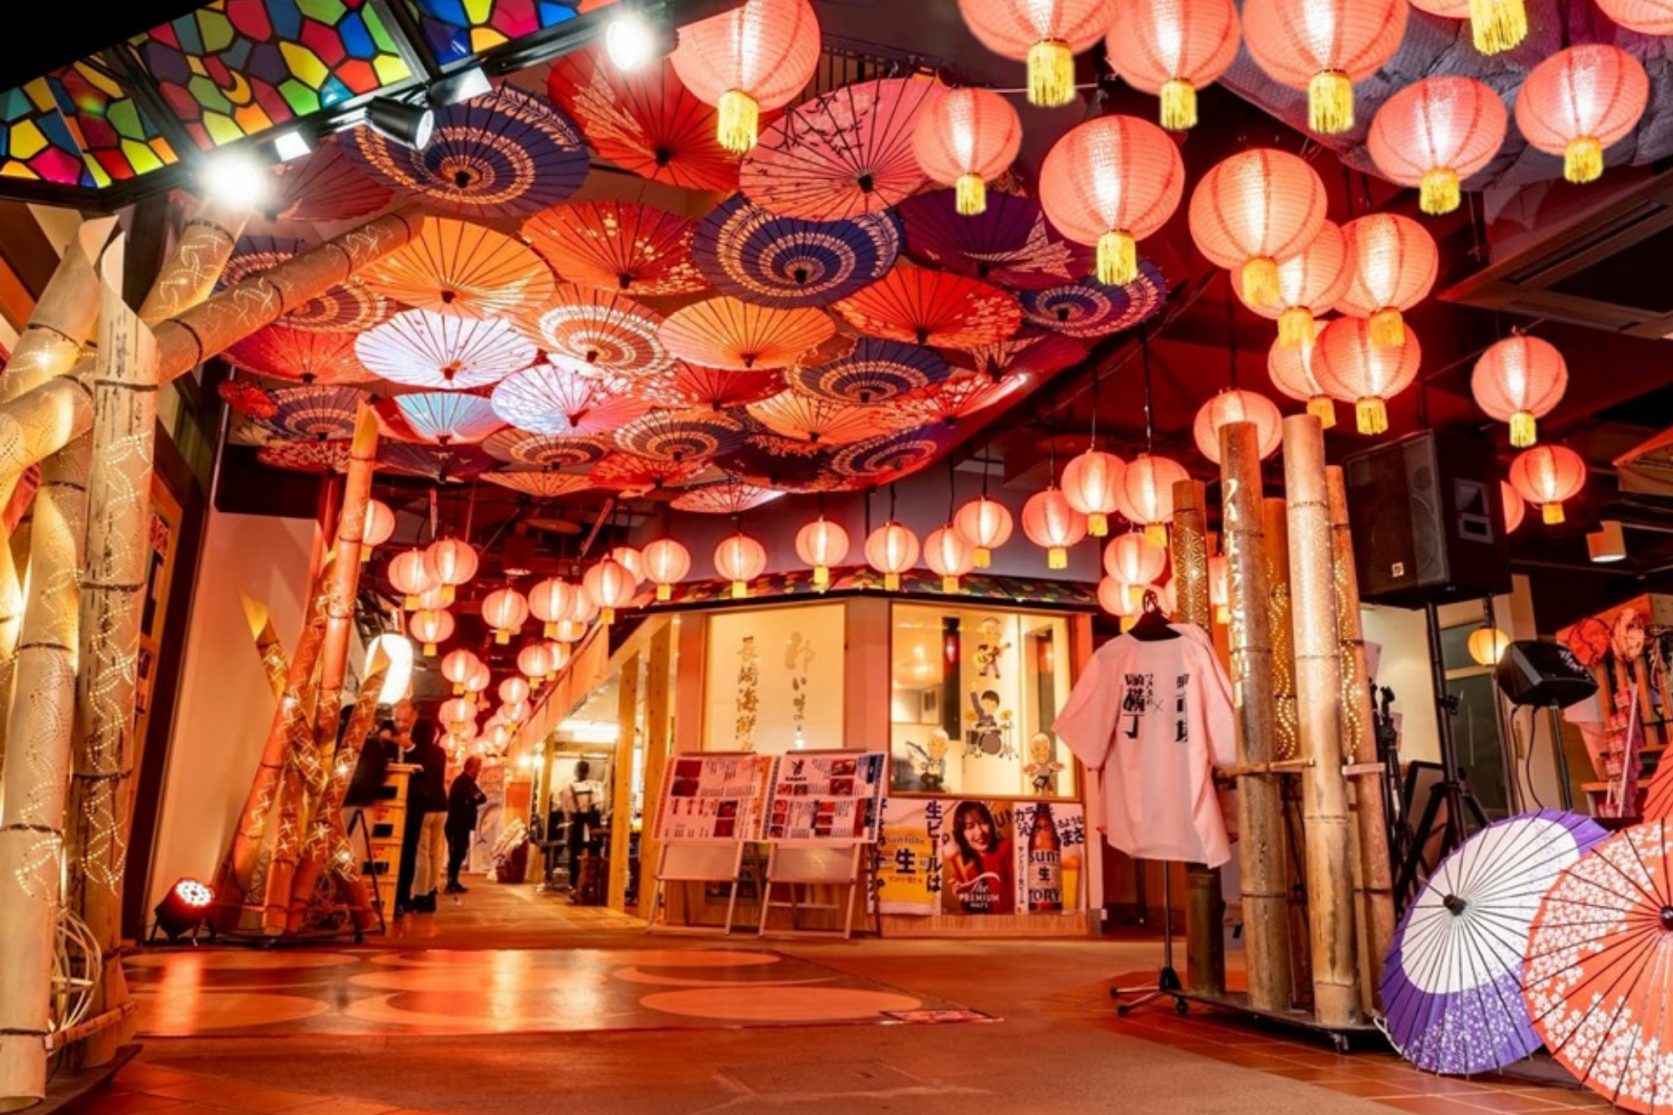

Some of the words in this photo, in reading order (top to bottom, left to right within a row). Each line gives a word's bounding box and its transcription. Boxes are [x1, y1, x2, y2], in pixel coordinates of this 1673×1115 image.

[925, 799, 942, 893] 生ビールは
[895, 848, 916, 874] 生
[1038, 867, 1051, 881] 生
[958, 893, 1000, 902] PREMIUM
